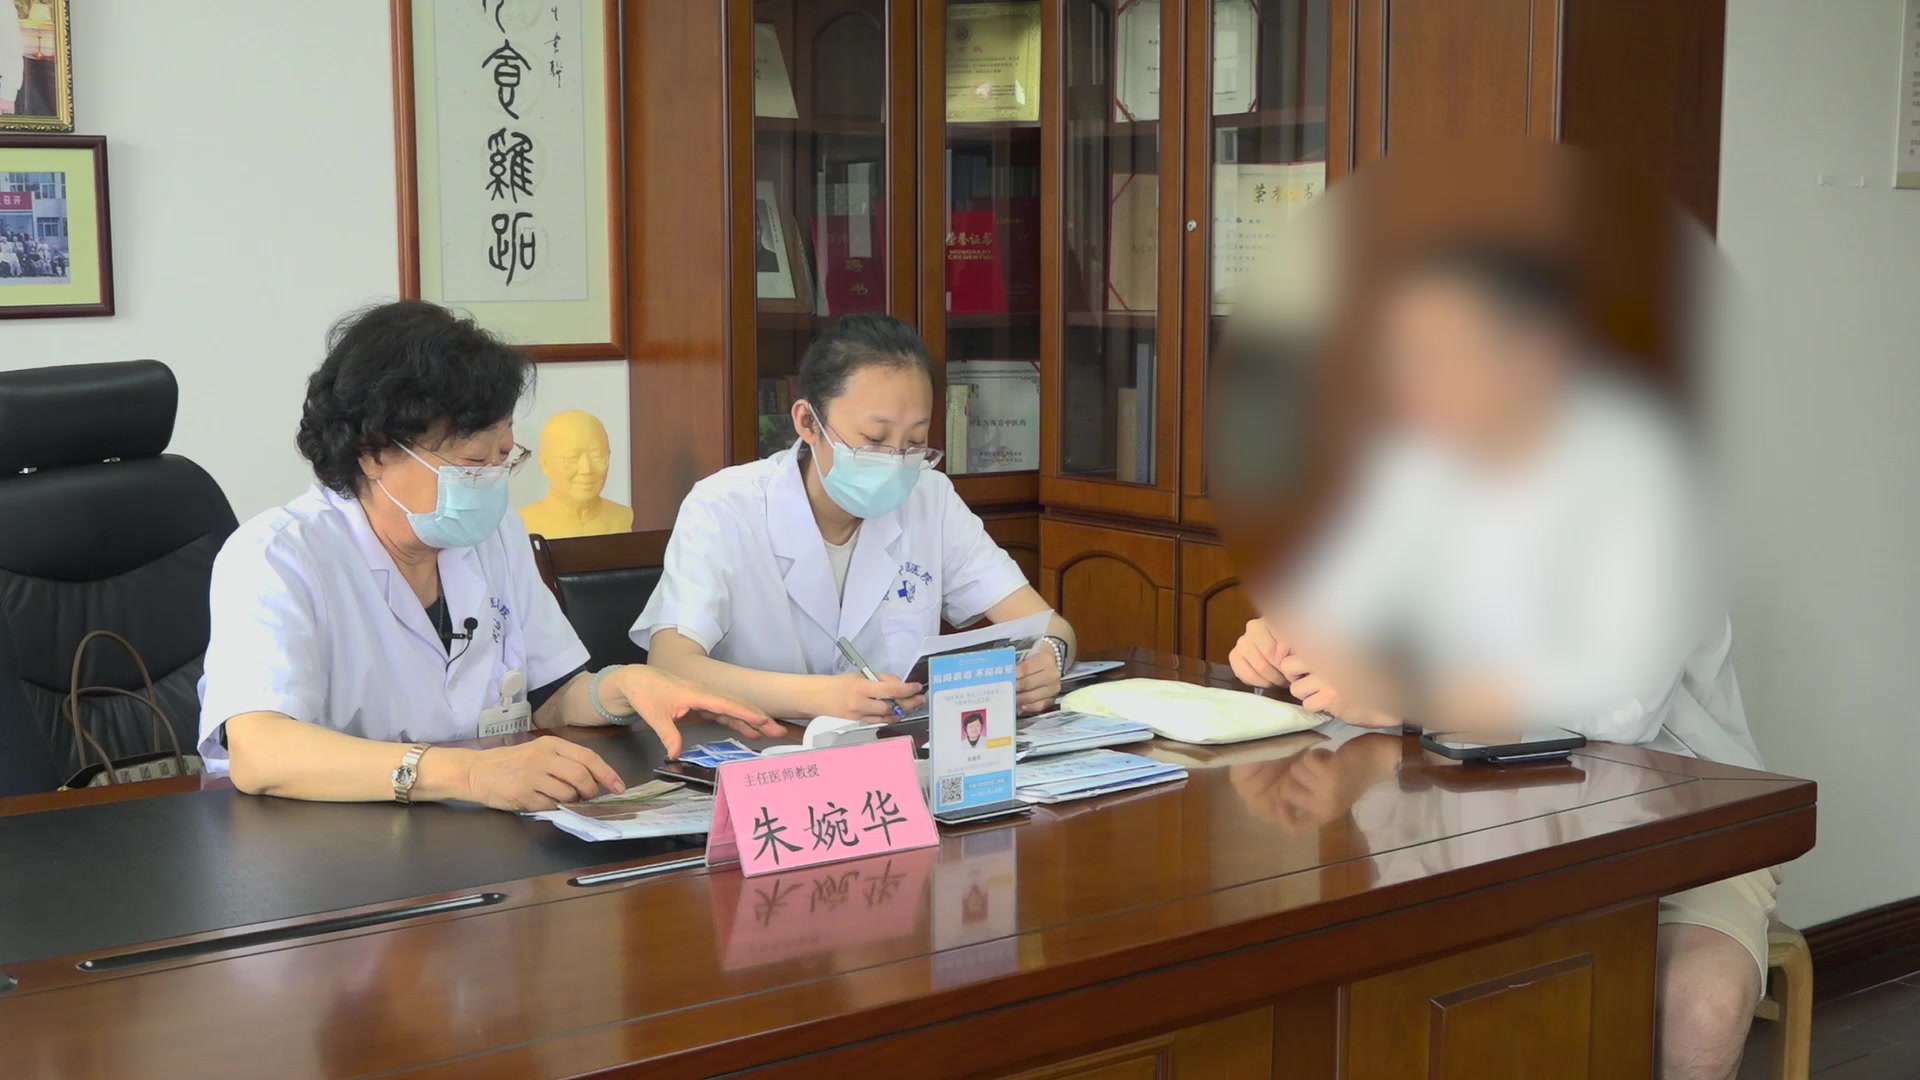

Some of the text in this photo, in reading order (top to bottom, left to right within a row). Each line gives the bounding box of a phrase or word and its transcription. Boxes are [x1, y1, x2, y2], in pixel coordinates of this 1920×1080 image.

[0, 194, 22, 206] 召开
[1253, 182, 1315, 204] 荣誉书
[743, 763, 821, 788] 主任医师教授
[752, 789, 908, 866] 朱婉华
